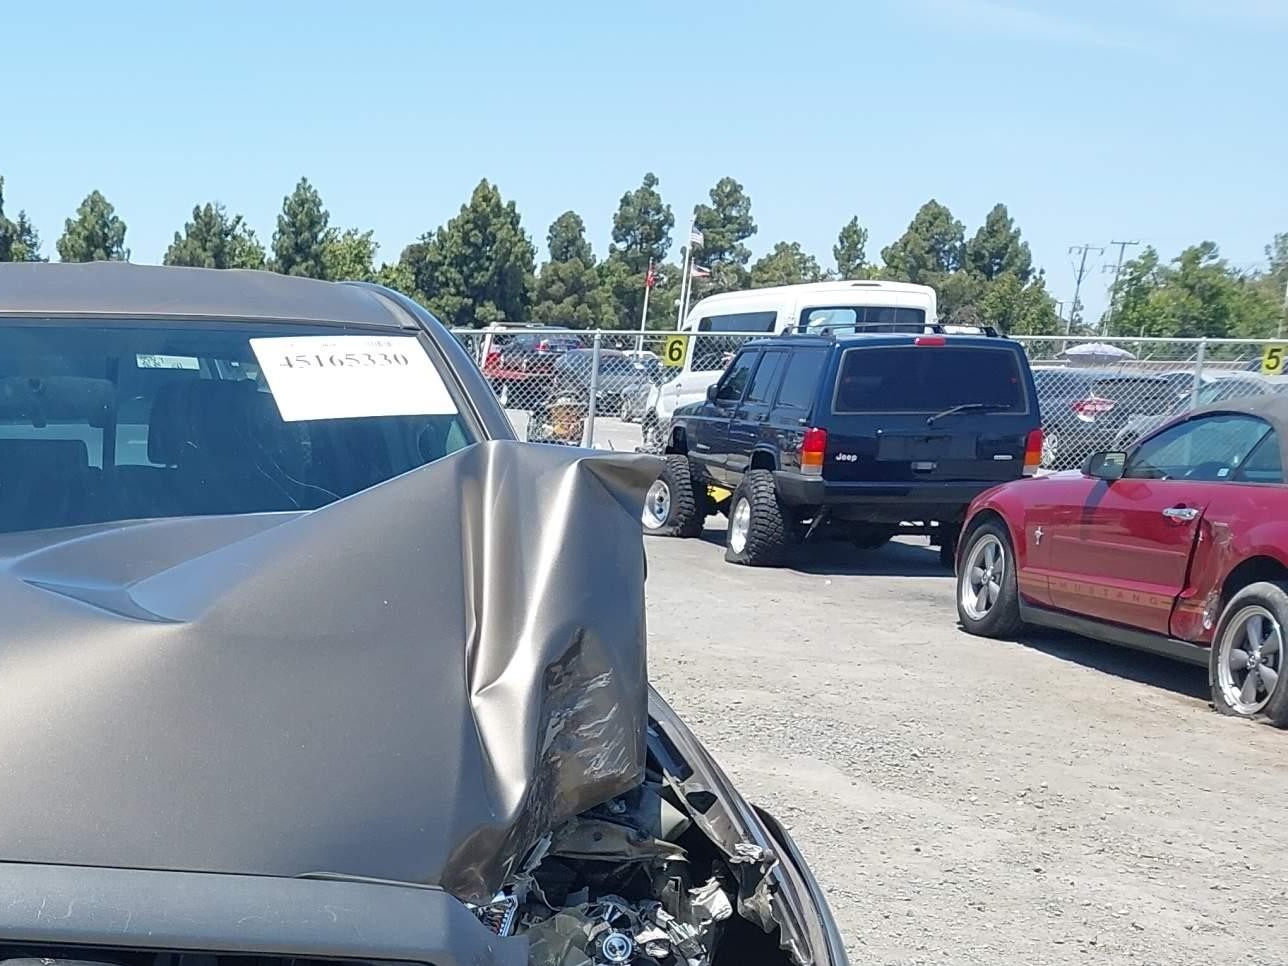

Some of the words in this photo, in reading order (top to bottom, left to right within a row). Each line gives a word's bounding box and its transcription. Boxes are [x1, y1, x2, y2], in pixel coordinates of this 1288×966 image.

[279, 353, 409, 369] 45165330
[668, 339, 684, 362] 6
[1265, 348, 1282, 371] 5
[835, 452, 858, 463] Jeep
[1059, 580, 1158, 605] MUSTANG
